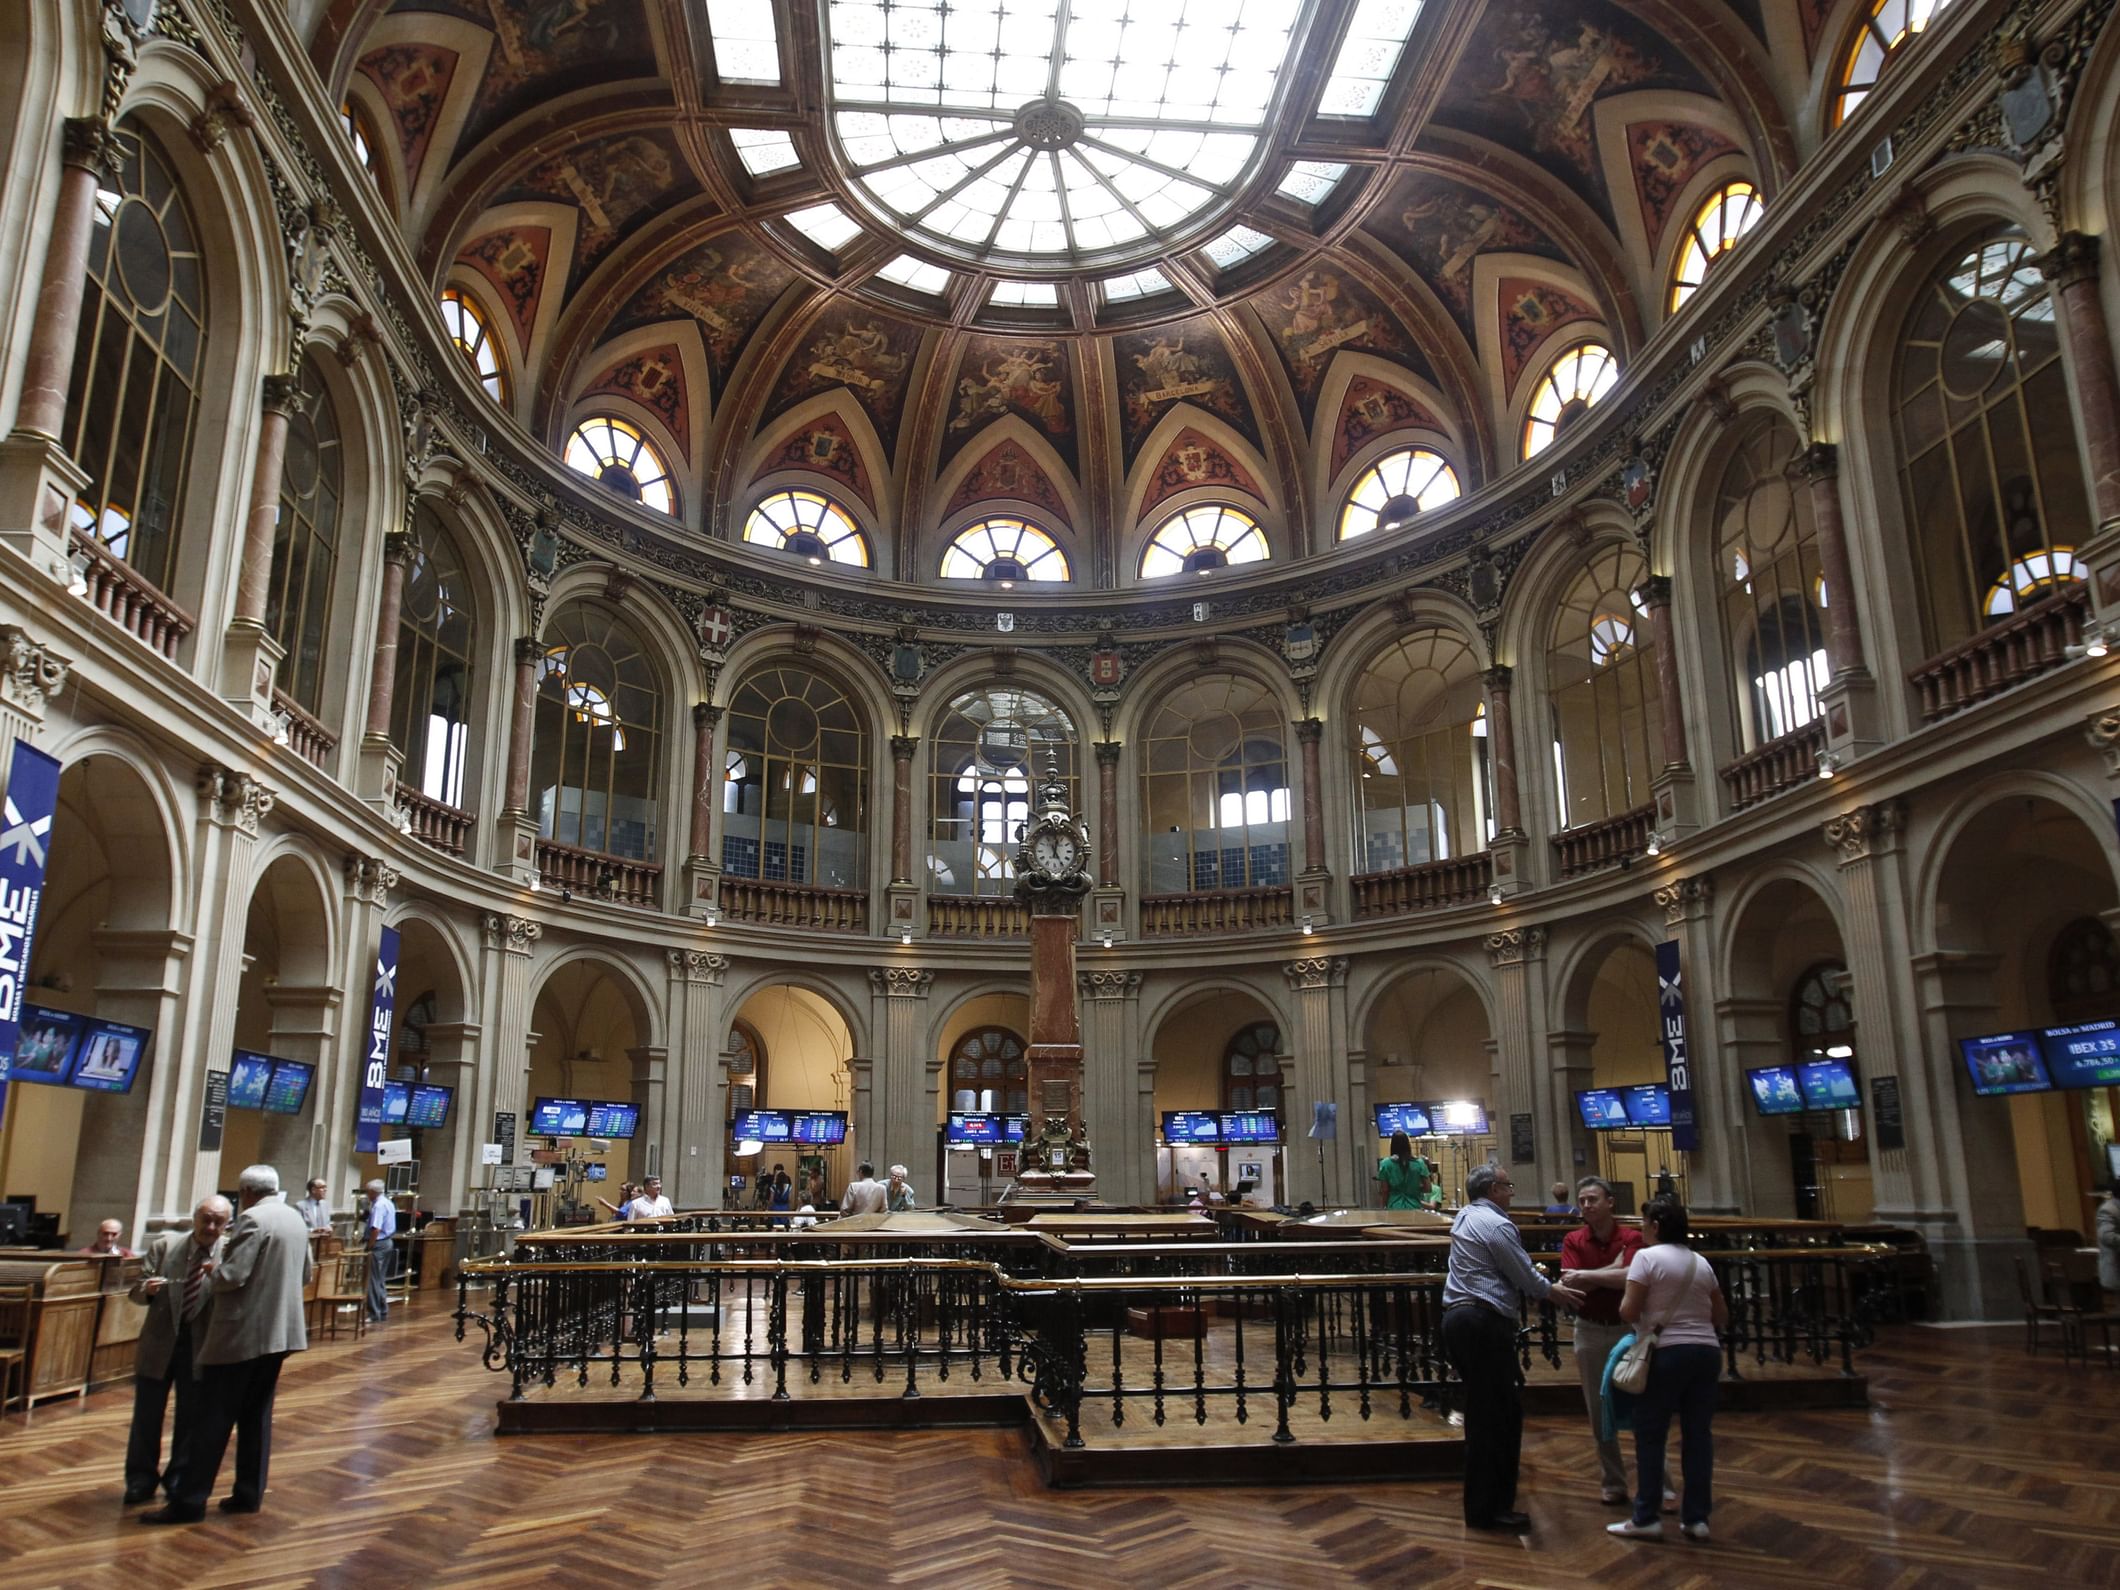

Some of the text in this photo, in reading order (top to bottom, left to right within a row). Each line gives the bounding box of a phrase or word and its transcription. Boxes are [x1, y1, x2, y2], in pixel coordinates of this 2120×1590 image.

[1155, 385, 1199, 400] BARCELONA
[10, 989, 24, 1023] BOLSAS
[18, 935, 32, 983] MERCADOS
[366, 1006, 390, 1089] BME
[1666, 1014, 1687, 1091] BME
[2045, 1027, 2072, 1037] BOLSA
[2079, 1021, 2116, 1032] MADRID
[2068, 1038, 2117, 1055] IBEX 35
